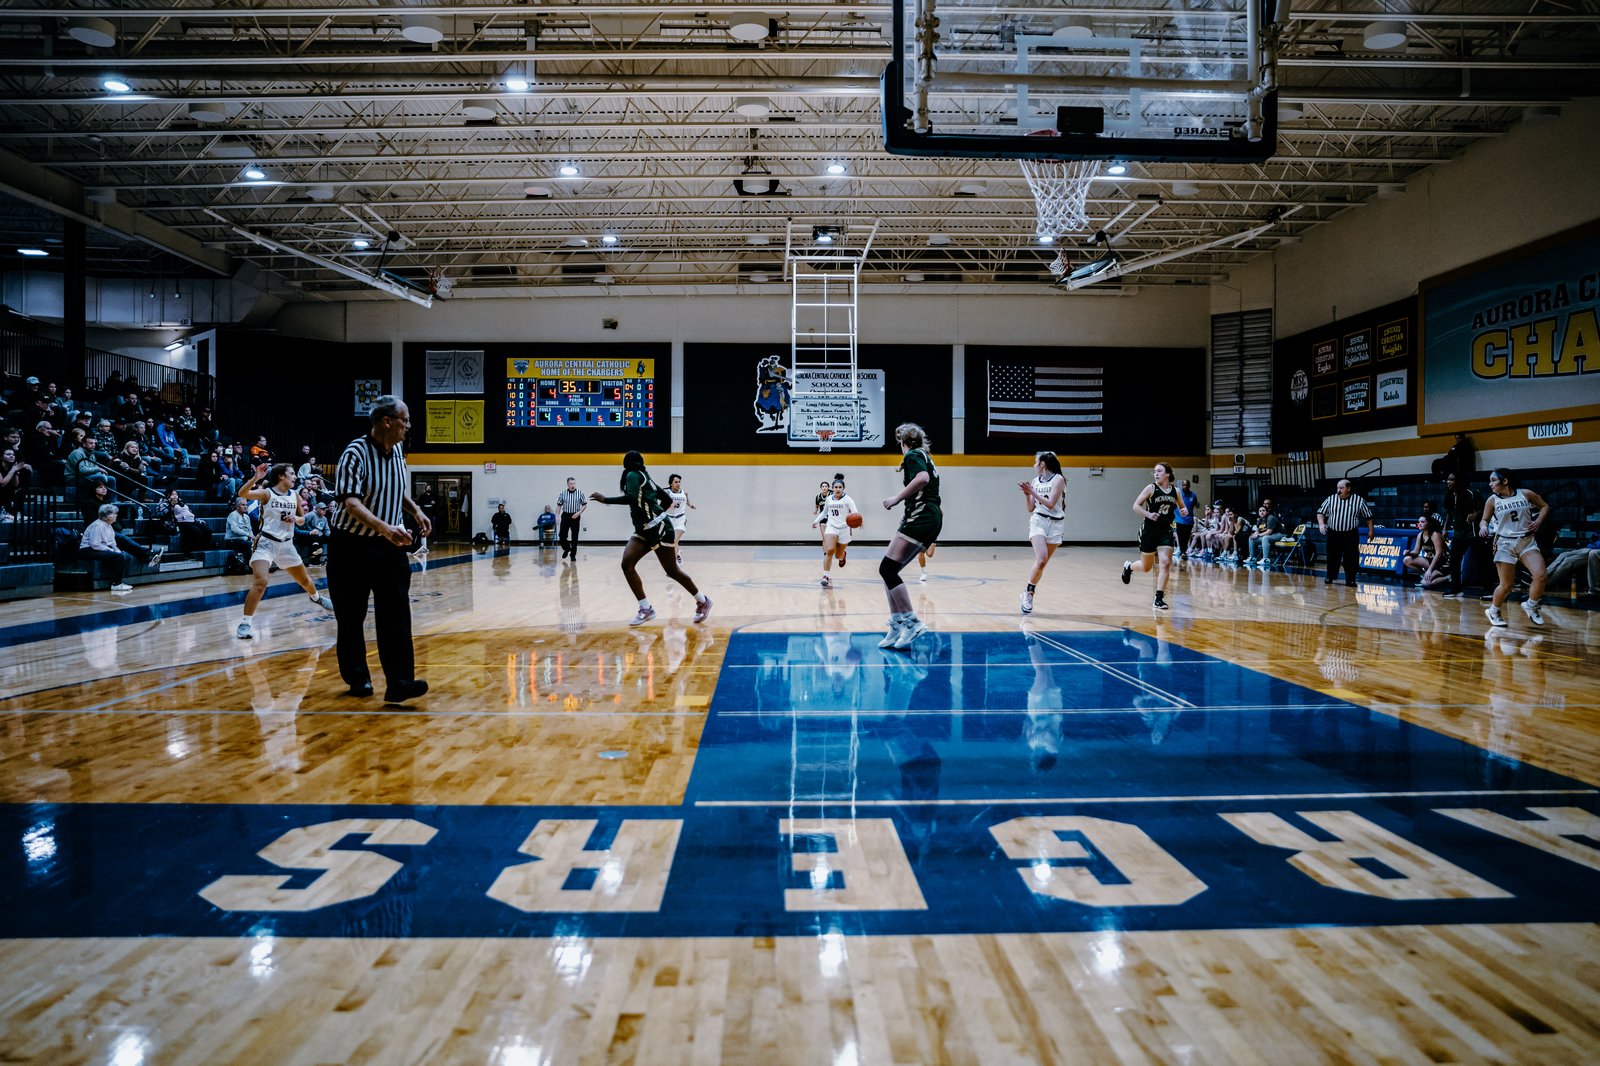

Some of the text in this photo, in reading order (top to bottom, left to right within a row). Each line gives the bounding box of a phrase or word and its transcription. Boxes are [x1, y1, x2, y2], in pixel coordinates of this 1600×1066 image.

[1472, 272, 1600, 330] AURORA C
[1384, 326, 1401, 336] CHICAGO
[1381, 333, 1403, 345] CHRISTIAN
[1383, 344, 1402, 356] Knights
[535, 360, 630, 368] AURORA CENTRAL CATHOLIC
[541, 368, 624, 377] HOME OF THE CHARGERS
[830, 372, 850, 380] CATHOLIC
[861, 372, 878, 380] SCHOOL
[549, 388, 557, 399] 4
[614, 388, 621, 400] 5
[1345, 391, 1367, 401] CONCEPTION
[1383, 390, 1400, 401] Rebels
[1347, 399, 1365, 411] Knights
[544, 412, 550, 421] 4
[616, 412, 621, 422] 3
[1531, 422, 1569, 437] VISITORS
[271, 500, 296, 510] CHARGER
[1496, 500, 1528, 512] CHARGERS
[1510, 510, 1518, 522] 2
[1386, 537, 1394, 545] TO
[1378, 545, 1401, 557] CENTRAL
[1364, 556, 1390, 568] CATHOLIC
